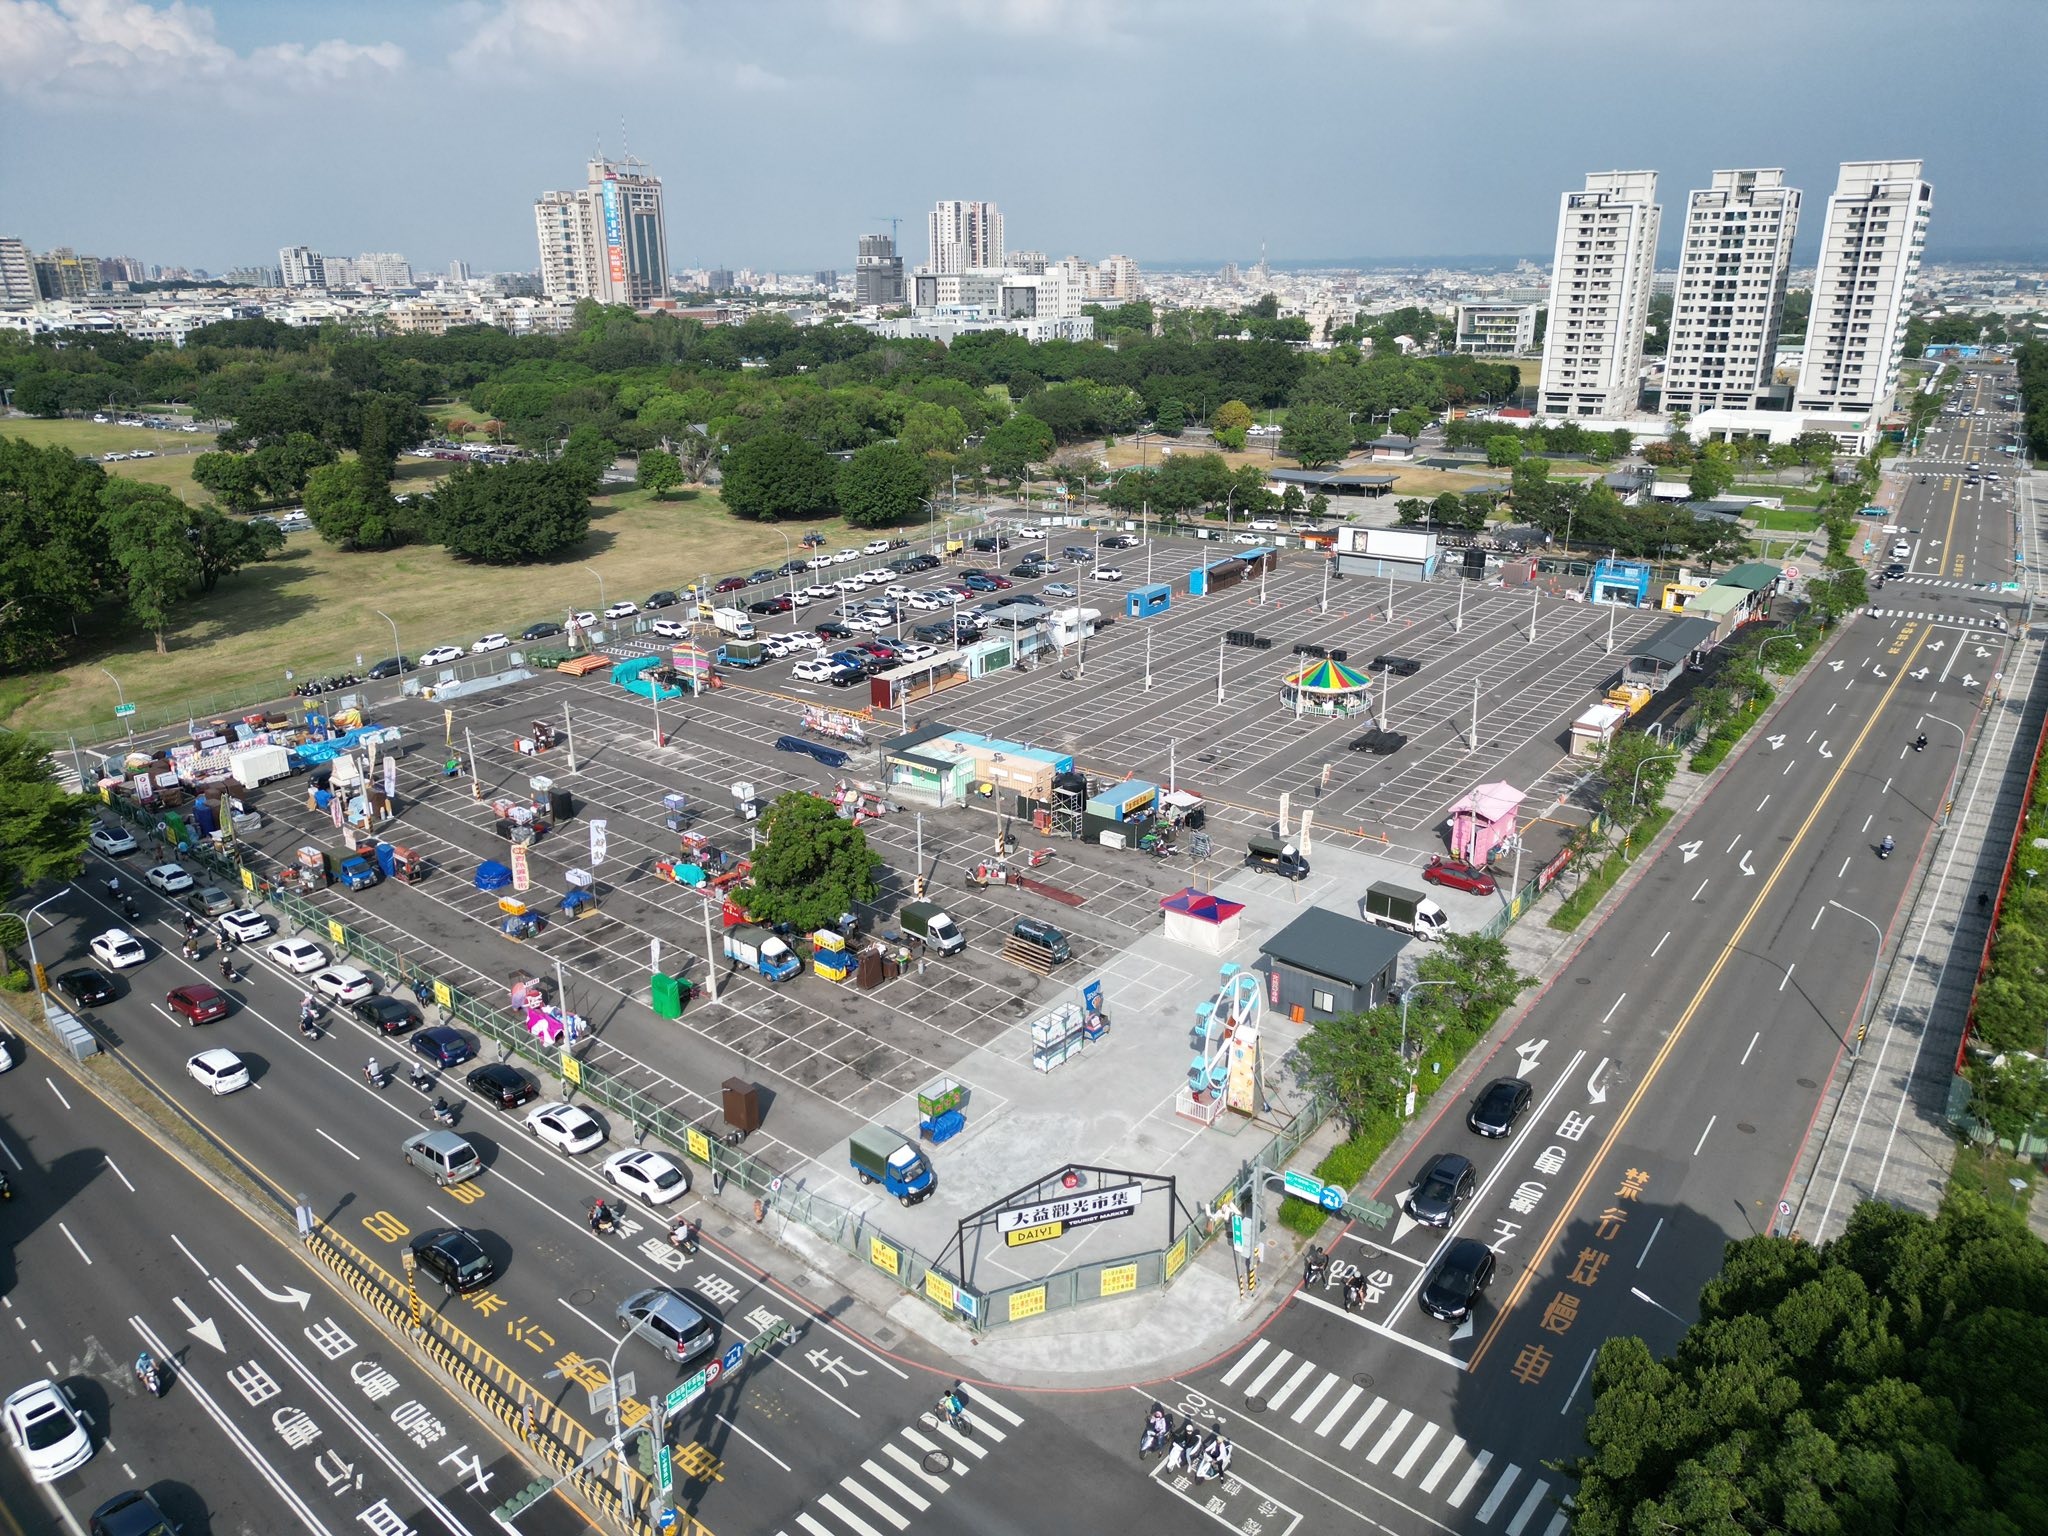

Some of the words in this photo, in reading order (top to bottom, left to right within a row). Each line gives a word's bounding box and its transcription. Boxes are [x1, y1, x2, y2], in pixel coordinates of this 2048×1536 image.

[1012, 1191, 1128, 1227] 大益觀光市集
[1068, 1215, 1098, 1226] TOURIST
[1099, 1209, 1129, 1220] MARKET
[361, 1210, 410, 1243] 60
[1018, 1226, 1052, 1242] DAIYI
[1510, 1167, 1650, 1385] 禁行機慢車
[706, 1366, 718, 1379] 60
[304, 1317, 494, 1494] 左彎專用
